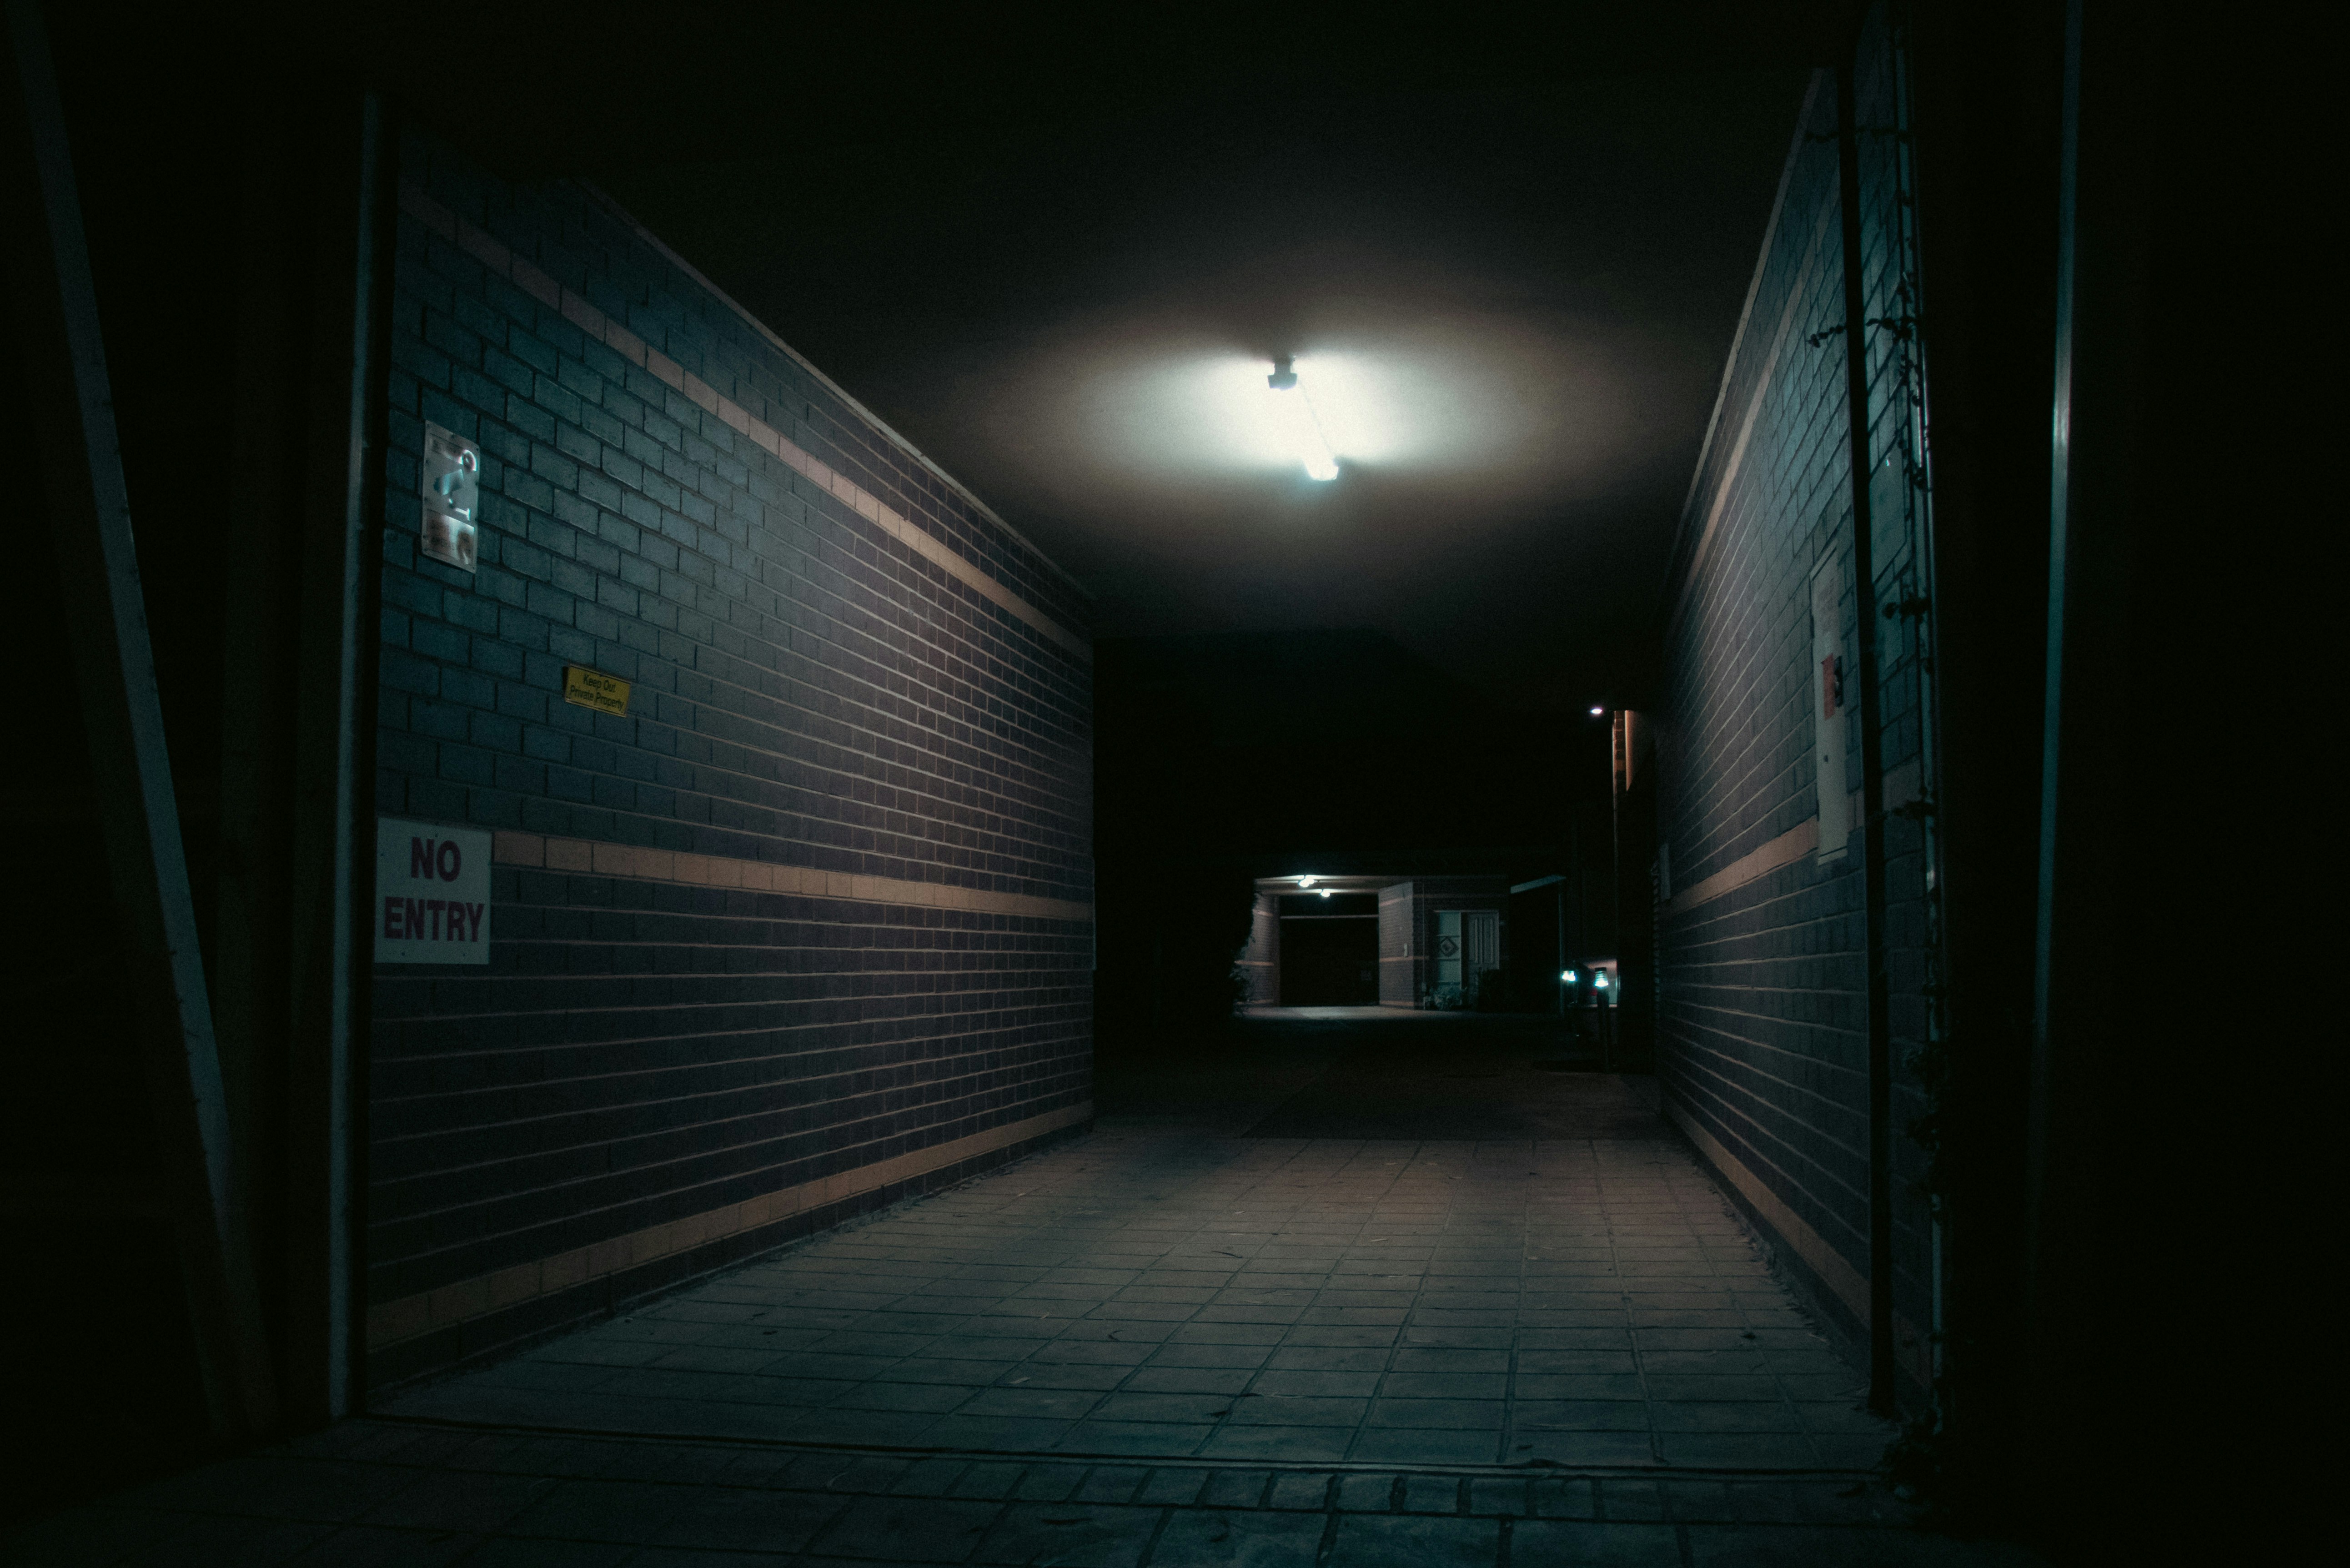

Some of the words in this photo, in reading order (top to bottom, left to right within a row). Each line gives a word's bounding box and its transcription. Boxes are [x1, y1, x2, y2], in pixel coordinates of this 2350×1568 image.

[569, 685, 594, 701] Private
[595, 692, 624, 711] Property
[583, 673, 601, 690] Keep
[603, 680, 616, 693] Out
[411, 837, 461, 882] NO
[385, 896, 485, 942] ENTRY
